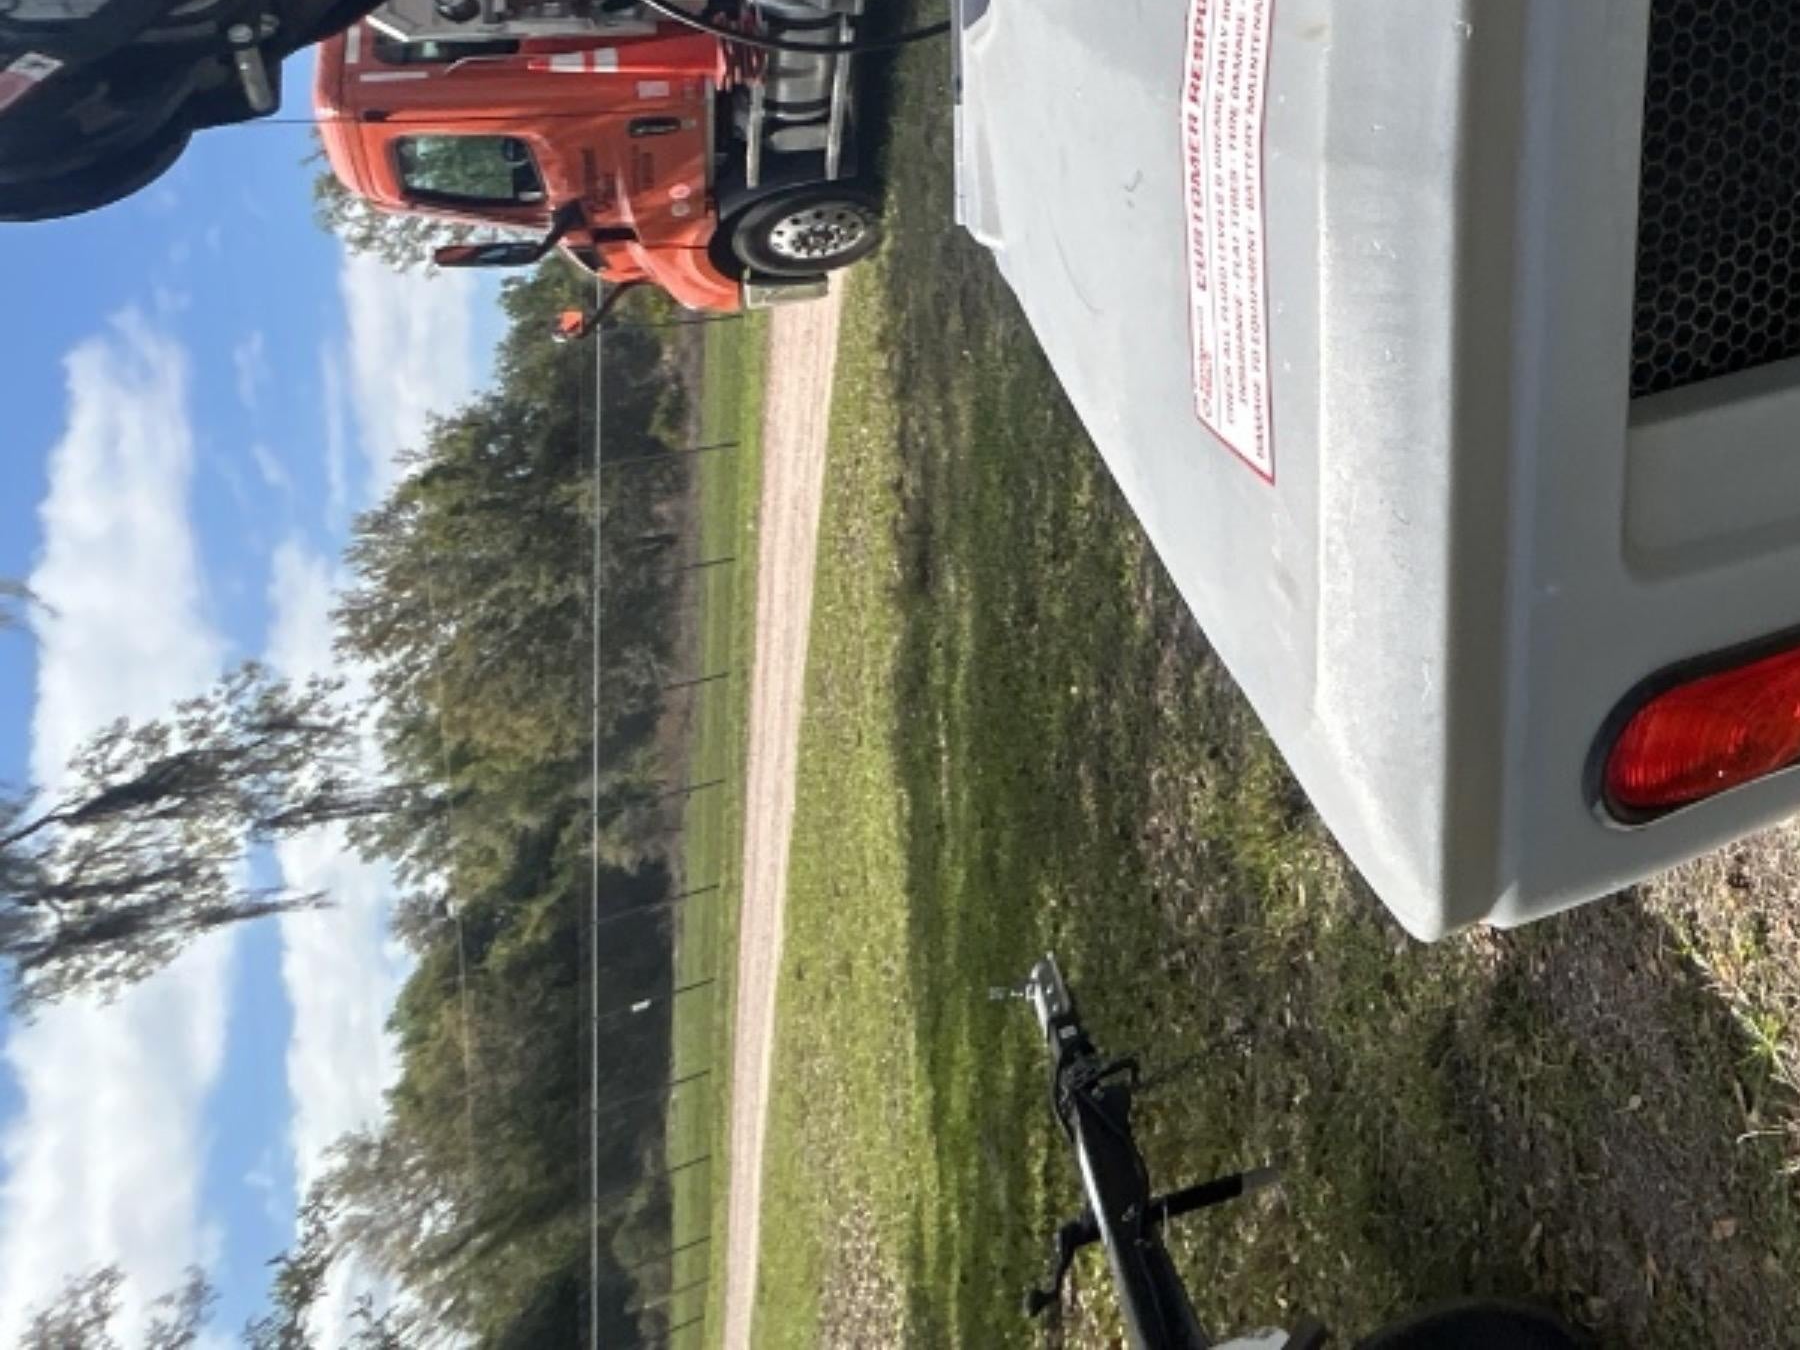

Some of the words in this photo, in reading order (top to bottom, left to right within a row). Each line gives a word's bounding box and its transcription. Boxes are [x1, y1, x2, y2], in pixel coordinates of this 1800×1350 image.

[1215, 25, 1228, 87] DAILY
[1230, 12, 1245, 100] DAMAGE
[1228, 105, 1239, 151] TIRE
[1229, 167, 1240, 229] TIRES
[1244, 120, 1255, 211] BATTERY
[1188, 114, 1206, 291] CUSTOMER
[1214, 192, 1225, 262] LEVELS
[1231, 235, 1242, 280] FLAT
[1246, 226, 1260, 345] EQUIPMENT
[1219, 267, 1228, 322] FLUID
[1234, 295, 1248, 406] INSURANCE
[1223, 365, 1234, 424] CHECK
[1253, 380, 1265, 459] DAMAGE
